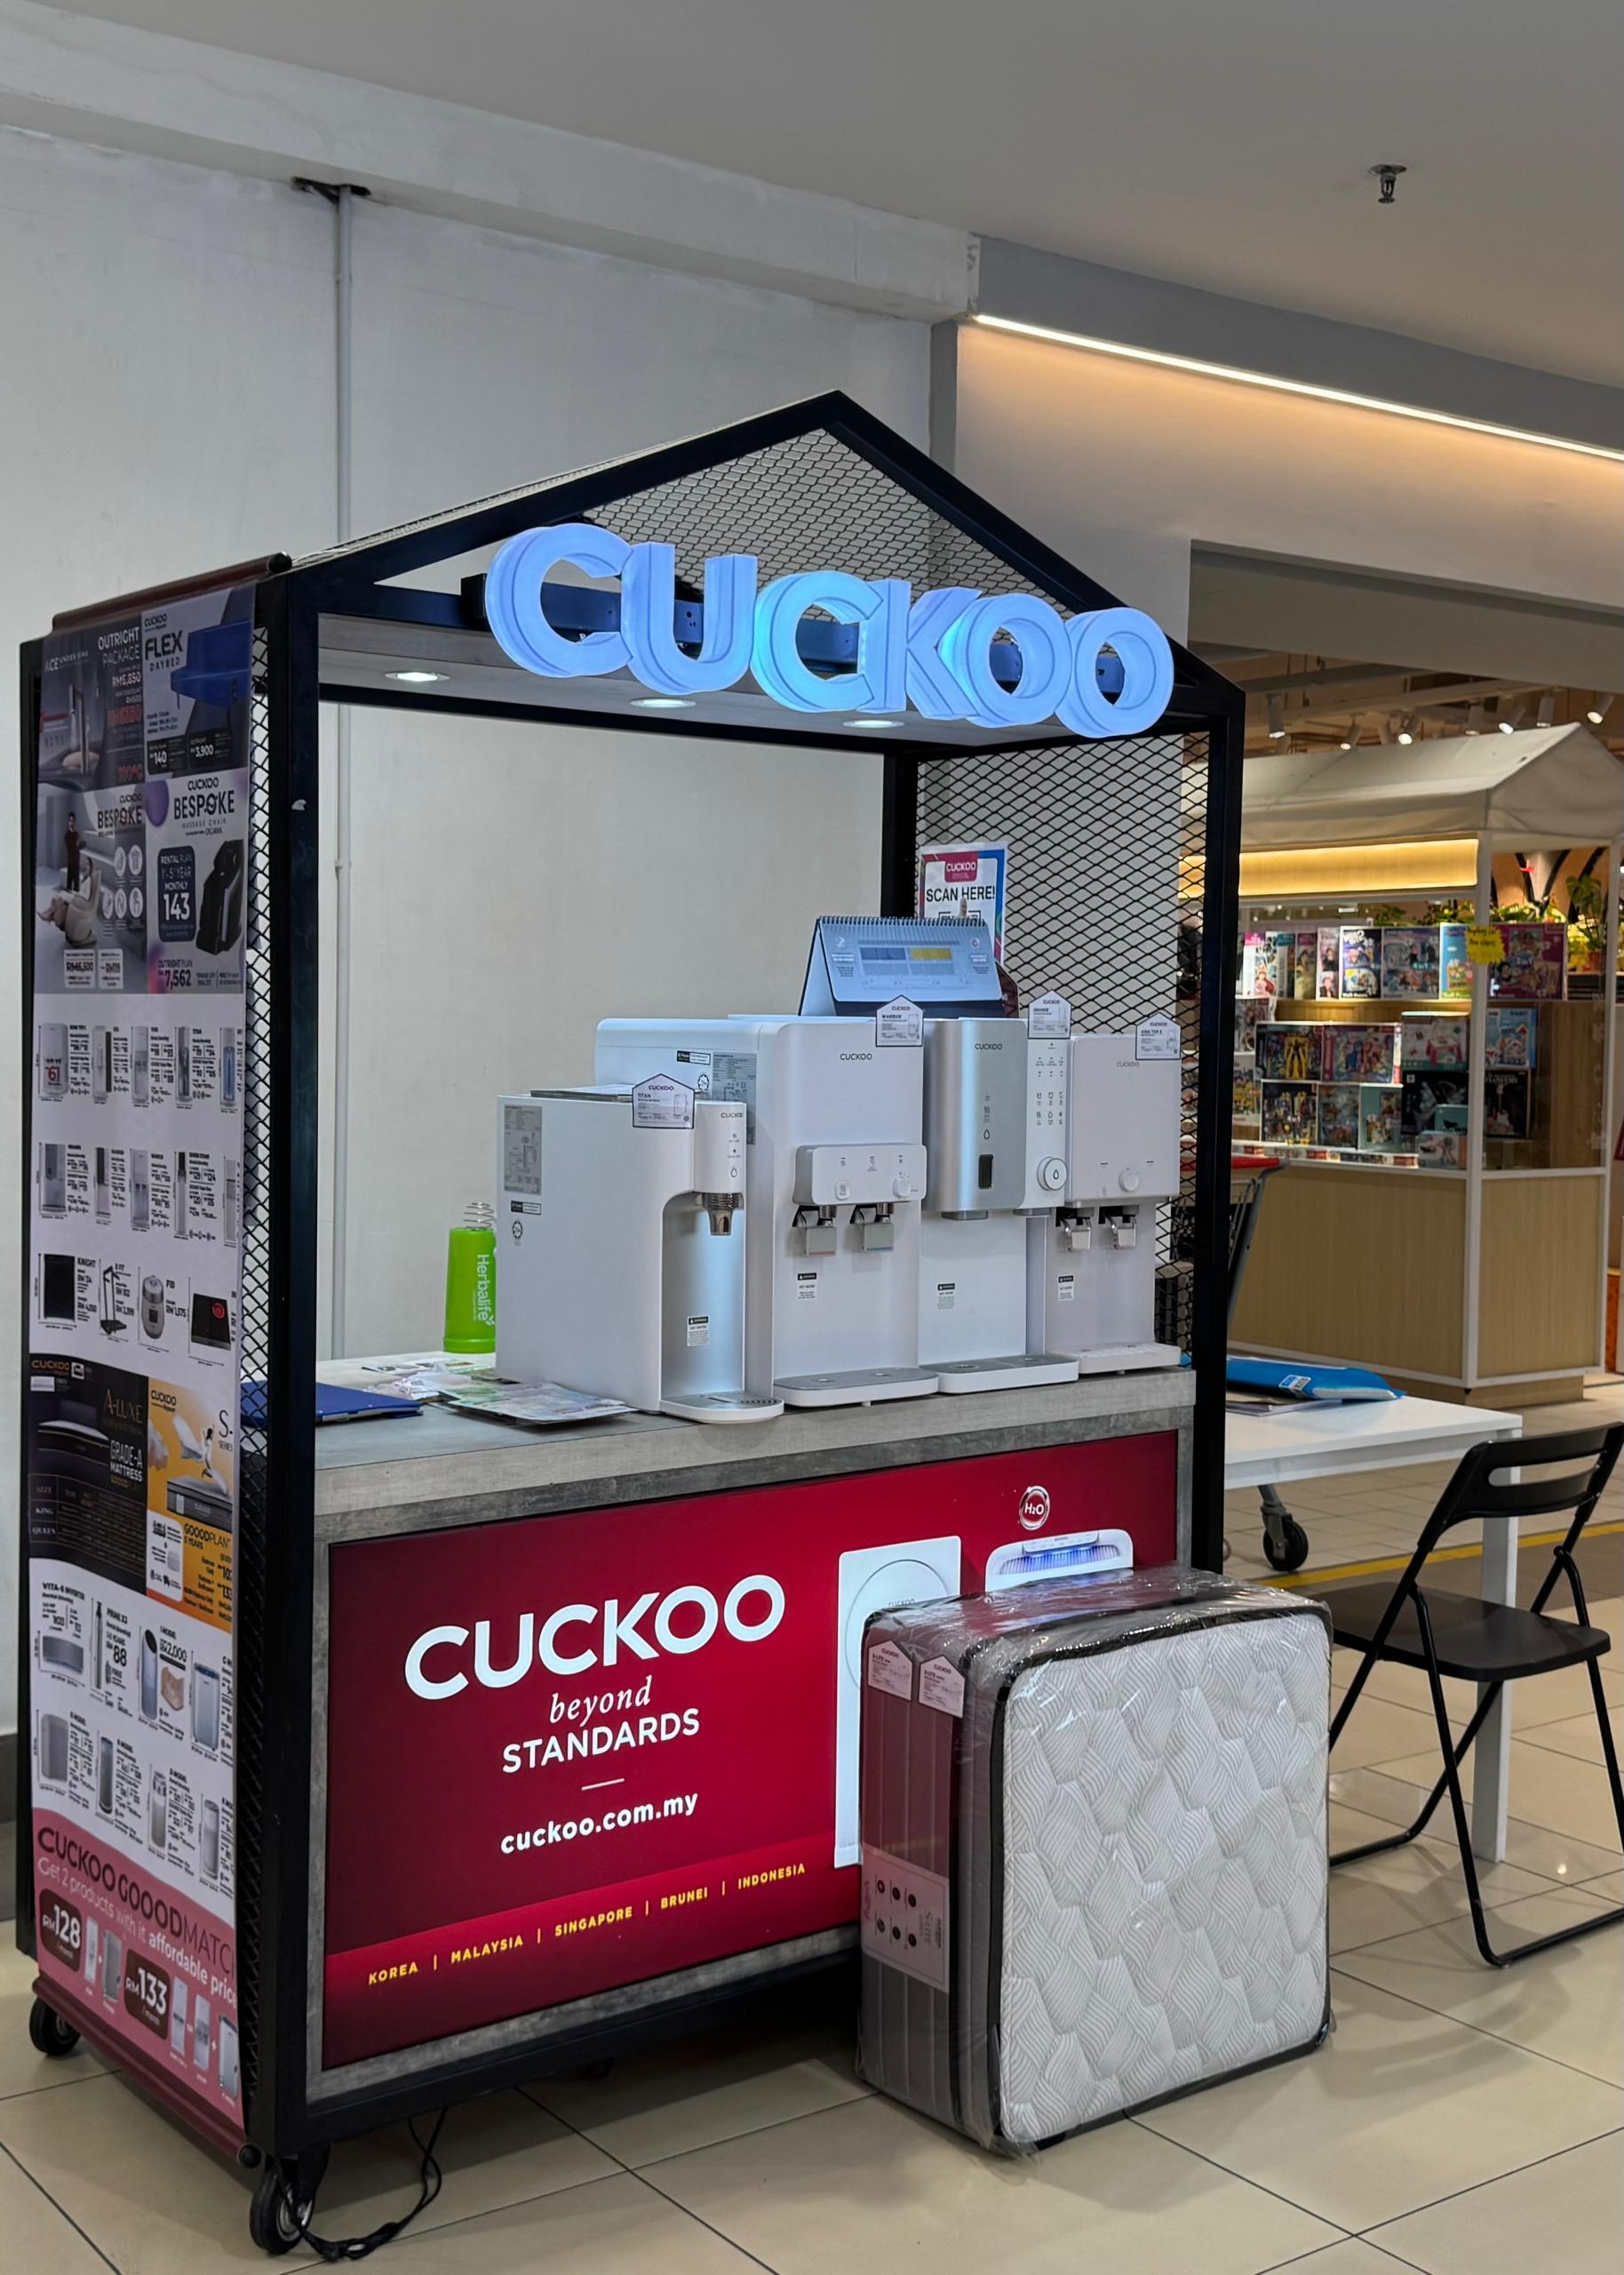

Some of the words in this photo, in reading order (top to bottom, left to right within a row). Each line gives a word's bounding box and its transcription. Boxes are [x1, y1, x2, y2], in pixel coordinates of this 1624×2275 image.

[98, 627, 140, 651] OUTRIGHT
[485, 522, 1174, 738] CUCKOO
[102, 643, 141, 666] PACKAGE
[145, 630, 184, 660] FLEX
[149, 658, 180, 672] DAYBED
[154, 751, 167, 765] 140
[187, 777, 219, 791] CUCKOO
[98, 805, 143, 829] BESPOKE
[173, 790, 235, 820] BESPOKE
[945, 860, 977, 873] CUCKOO
[926, 888, 959, 903] SCAN
[962, 885, 996, 901] HERE!
[163, 892, 190, 922] 143
[165, 969, 192, 989] 7,562
[840, 1052, 873, 1061] CUCKOO
[974, 1042, 1003, 1051] CUCKOO
[476, 1254, 490, 1321] Herbalife
[150, 1389, 178, 1406] CUCKOO
[109, 1439, 143, 1469] GRADE-A
[109, 1460, 143, 1482] MATTRESS
[404, 1574, 786, 1701] CUCKOO
[113, 1644, 127, 1667] 88
[549, 1674, 653, 1728] beyond
[501, 1707, 700, 1774] STANDARDS
[500, 1792, 699, 1855] cuckoo.com.my
[37, 1826, 115, 1892] CUCKOO
[37, 1856, 61, 1883] Get
[61, 1867, 69, 1887] 2
[69, 1877, 115, 1919] products
[115, 1906, 137, 1937] with
[137, 1920, 147, 1944] it
[148, 1931, 208, 1984] affordable
[368, 1960, 419, 1986] KOREA
[450, 1934, 524, 1965] MALAYSIA
[553, 1905, 633, 1938] SINGAPORE
[660, 1886, 709, 1911] BRUNEI
[736, 1862, 807, 1891] INDONESIA
